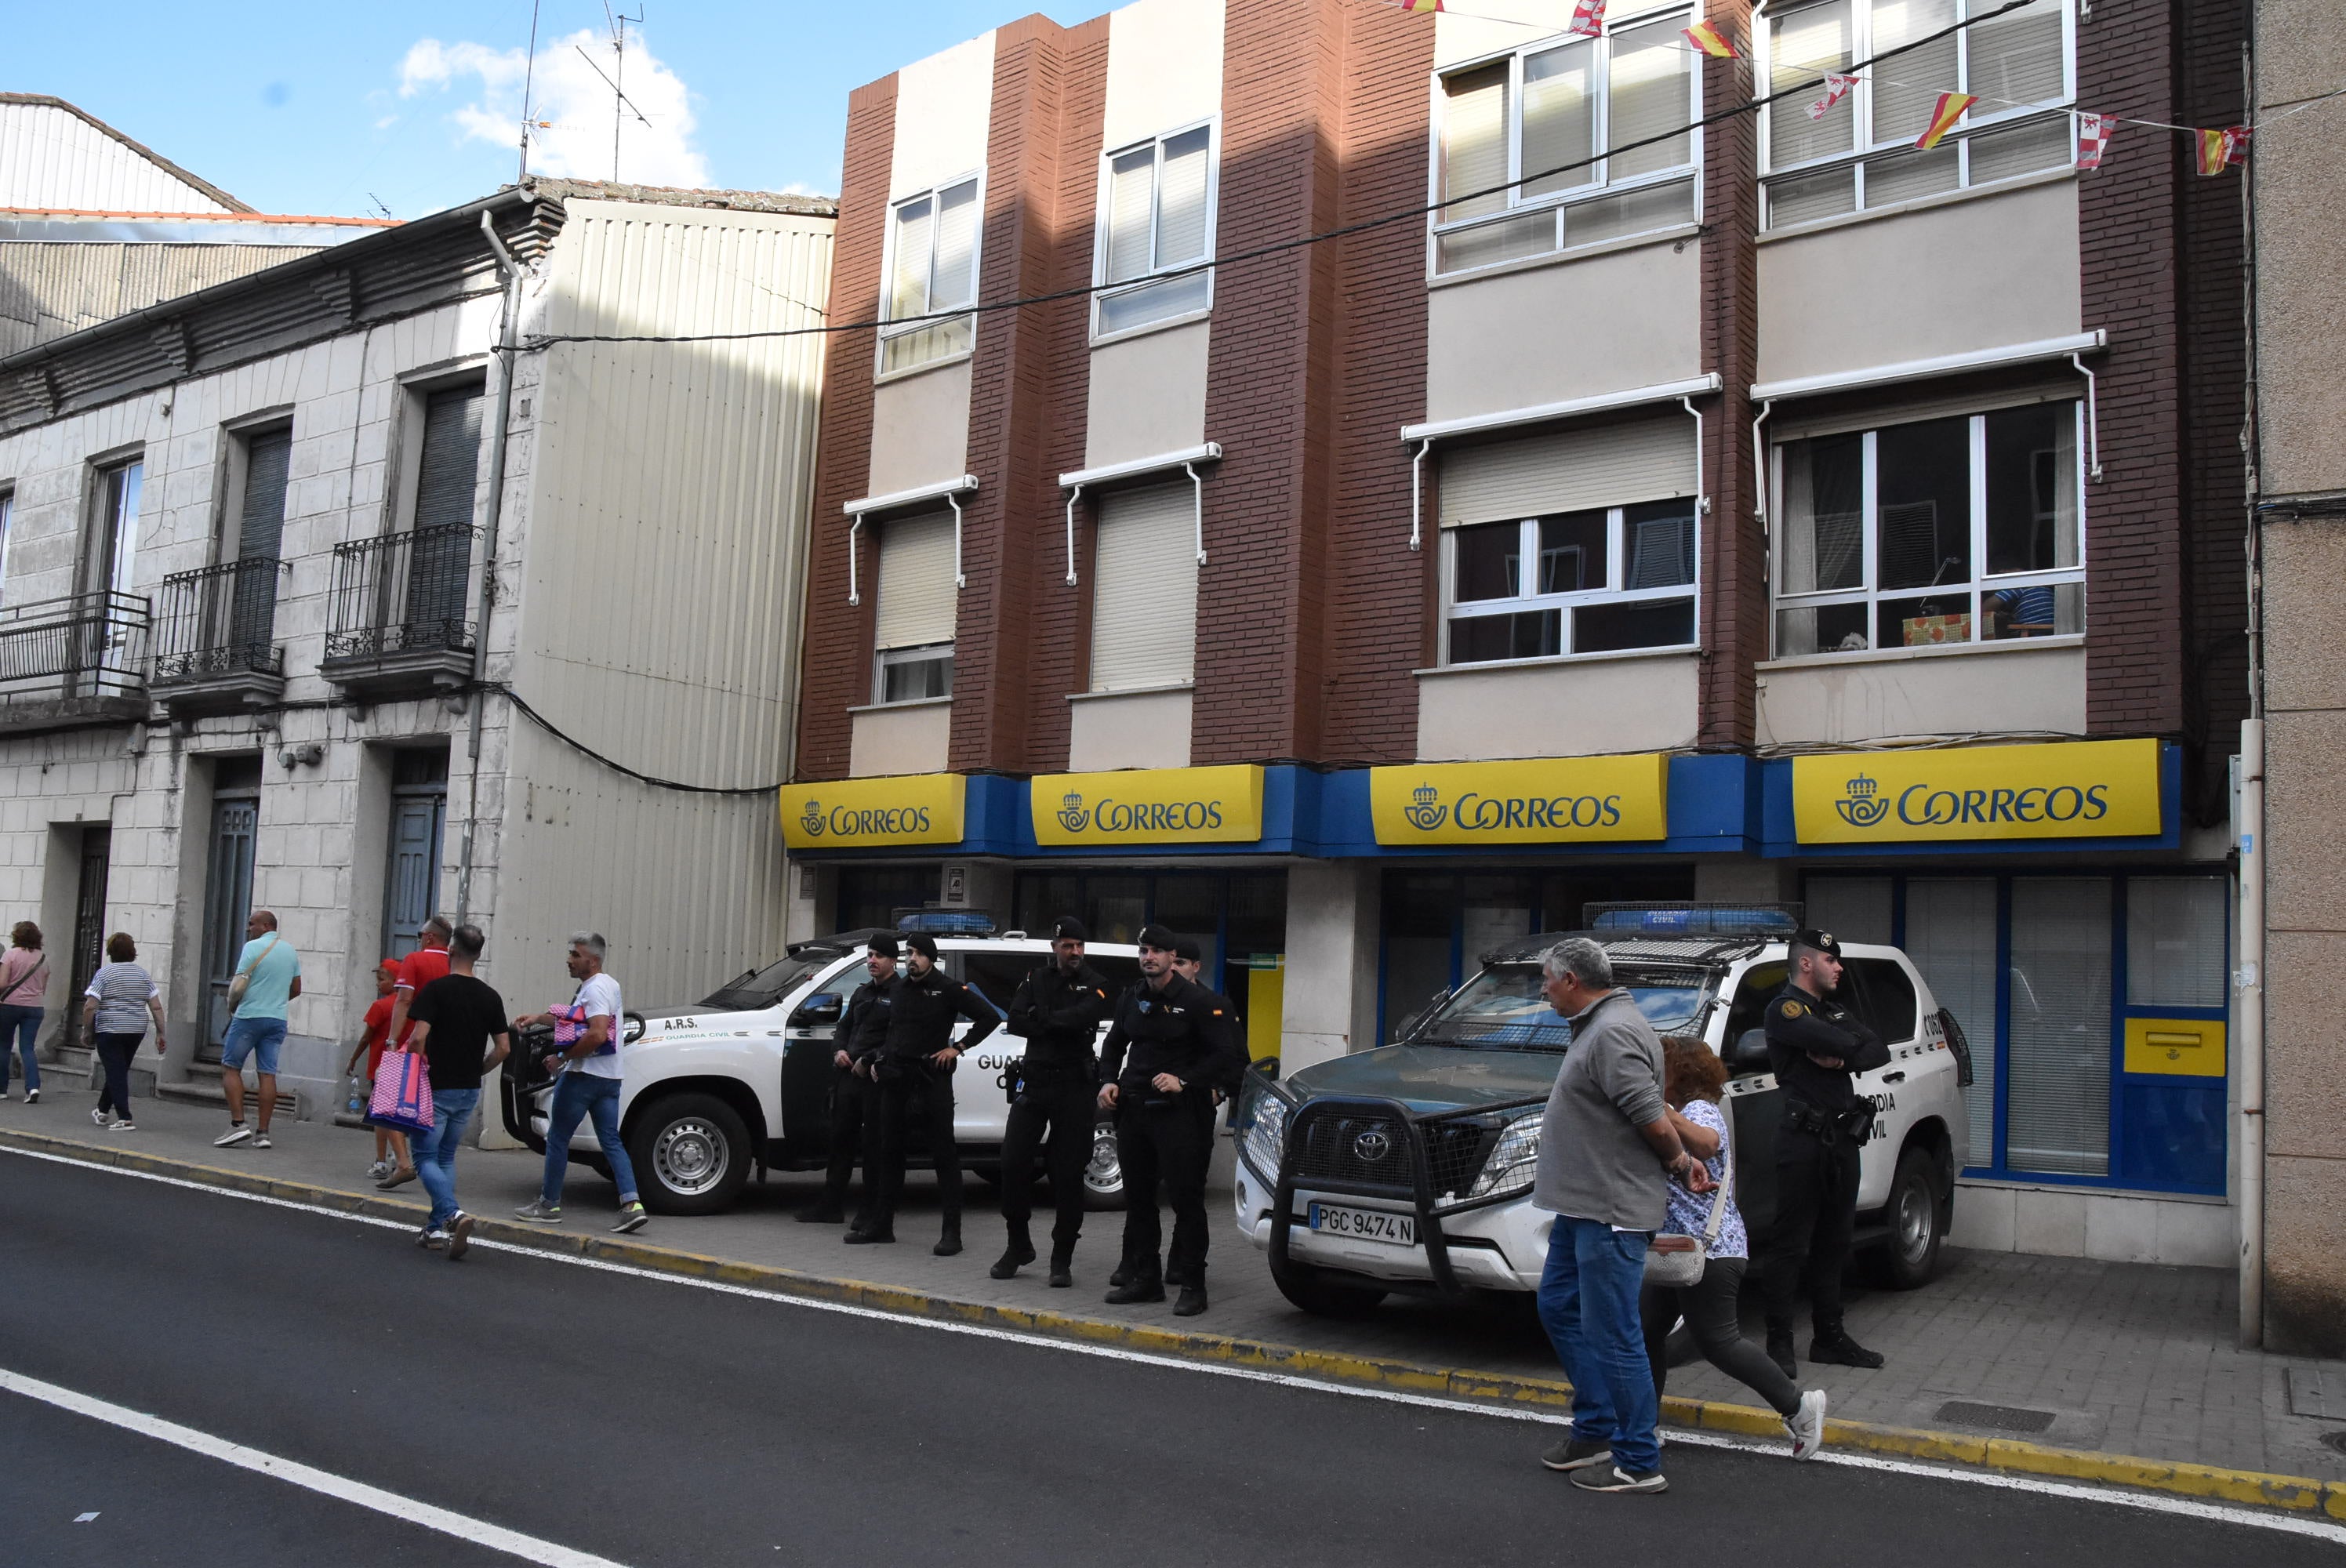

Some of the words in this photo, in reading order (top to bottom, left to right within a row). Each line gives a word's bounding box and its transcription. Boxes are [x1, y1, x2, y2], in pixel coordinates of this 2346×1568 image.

[664, 1018, 698, 1030] A.R.S.
[1320, 1208, 1349, 1231] PGC
[1353, 1214, 1396, 1239] 9474
[1400, 1220, 1411, 1240] N
